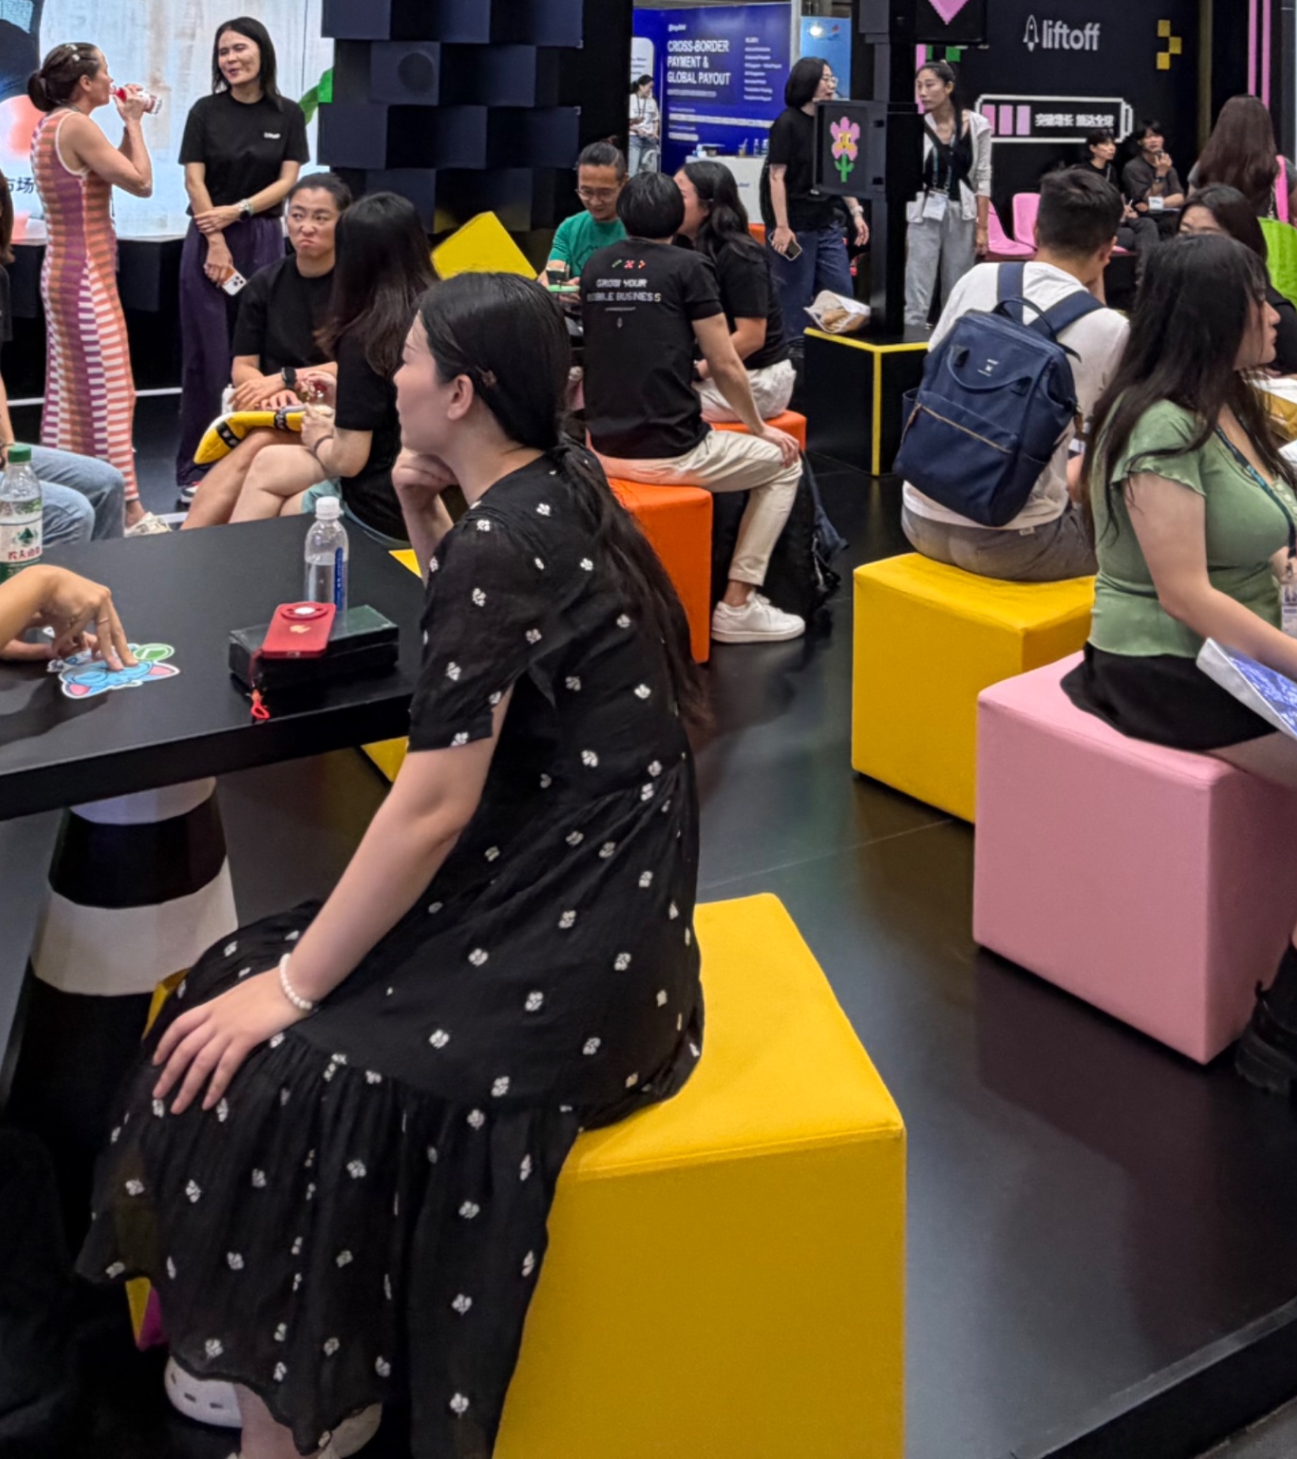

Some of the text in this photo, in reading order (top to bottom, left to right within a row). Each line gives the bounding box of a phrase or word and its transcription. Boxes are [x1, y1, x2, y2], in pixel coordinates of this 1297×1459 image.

[1042, 19, 1100, 51] liftoff
[667, 40, 730, 53] CROSS-BORDER
[667, 55, 709, 69] PAYMENT &
[667, 71, 731, 85] GLOBAL PAYOUT
[623, 279, 648, 288] YOUR
[616, 292, 662, 303] BUSINESS
